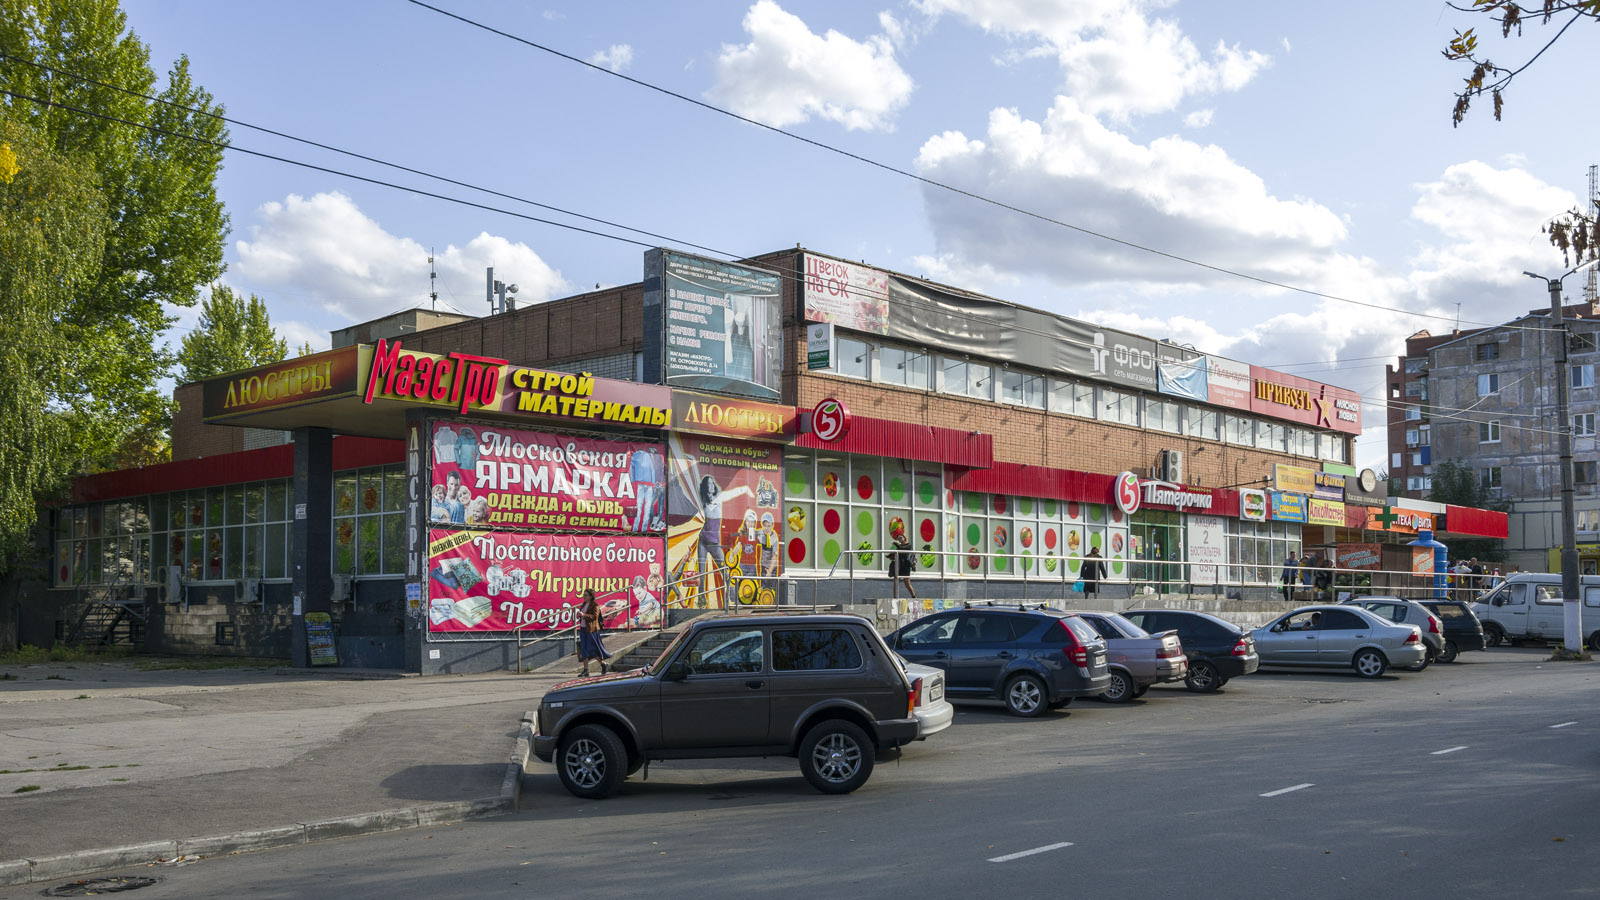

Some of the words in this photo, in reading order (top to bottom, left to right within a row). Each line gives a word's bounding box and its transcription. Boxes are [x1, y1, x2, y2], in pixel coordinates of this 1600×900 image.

[669, 289, 676, 297] В
[677, 290, 705, 303] НАШИХ
[669, 299, 683, 309] НЕТ
[684, 302, 712, 314] НИЧЕГО
[669, 324, 696, 337] НАЧНИ
[699, 330, 727, 342] РЕМОНТ
[670, 335, 676, 344] С
[224, 361, 333, 409] ЛЮСТРЫ
[513, 369, 595, 397] СТРОЙ
[1114, 369, 1125, 378] сеть
[1126, 371, 1153, 384] магазинов
[1256, 378, 1312, 411] ПРИВОЗЪ
[518, 392, 672, 426] МАТЕРИАЛЫ
[685, 401, 784, 434] ЛЮСТРЫ
[819, 410, 837, 438] 5
[479, 430, 628, 469] Московская
[700, 443, 733, 454] одежда
[712, 457, 751, 467] оптовым
[752, 462, 778, 471] ценам
[474, 460, 636, 500] ЯРМАРКА
[487, 492, 559, 513] ОДЕЖДА
[577, 498, 624, 516] ОБУВЬ
[1123, 482, 1136, 510] 5
[1281, 492, 1299, 504] Остров
[488, 510, 525, 524] ДЛЯ
[527, 513, 567, 526] ВСЕЙ
[569, 516, 619, 528] СЕМЬИ
[1194, 517, 1217, 529] АКЦИЯ
[1417, 517, 1432, 528] ВИТА
[431, 538, 456, 553] НИЗКИЕ
[454, 532, 472, 547] ЦЕНЫ
[1203, 530, 1209, 544] 2
[473, 535, 602, 563] Постельное
[605, 542, 657, 563] белье
[530, 568, 631, 598] Игрушки
